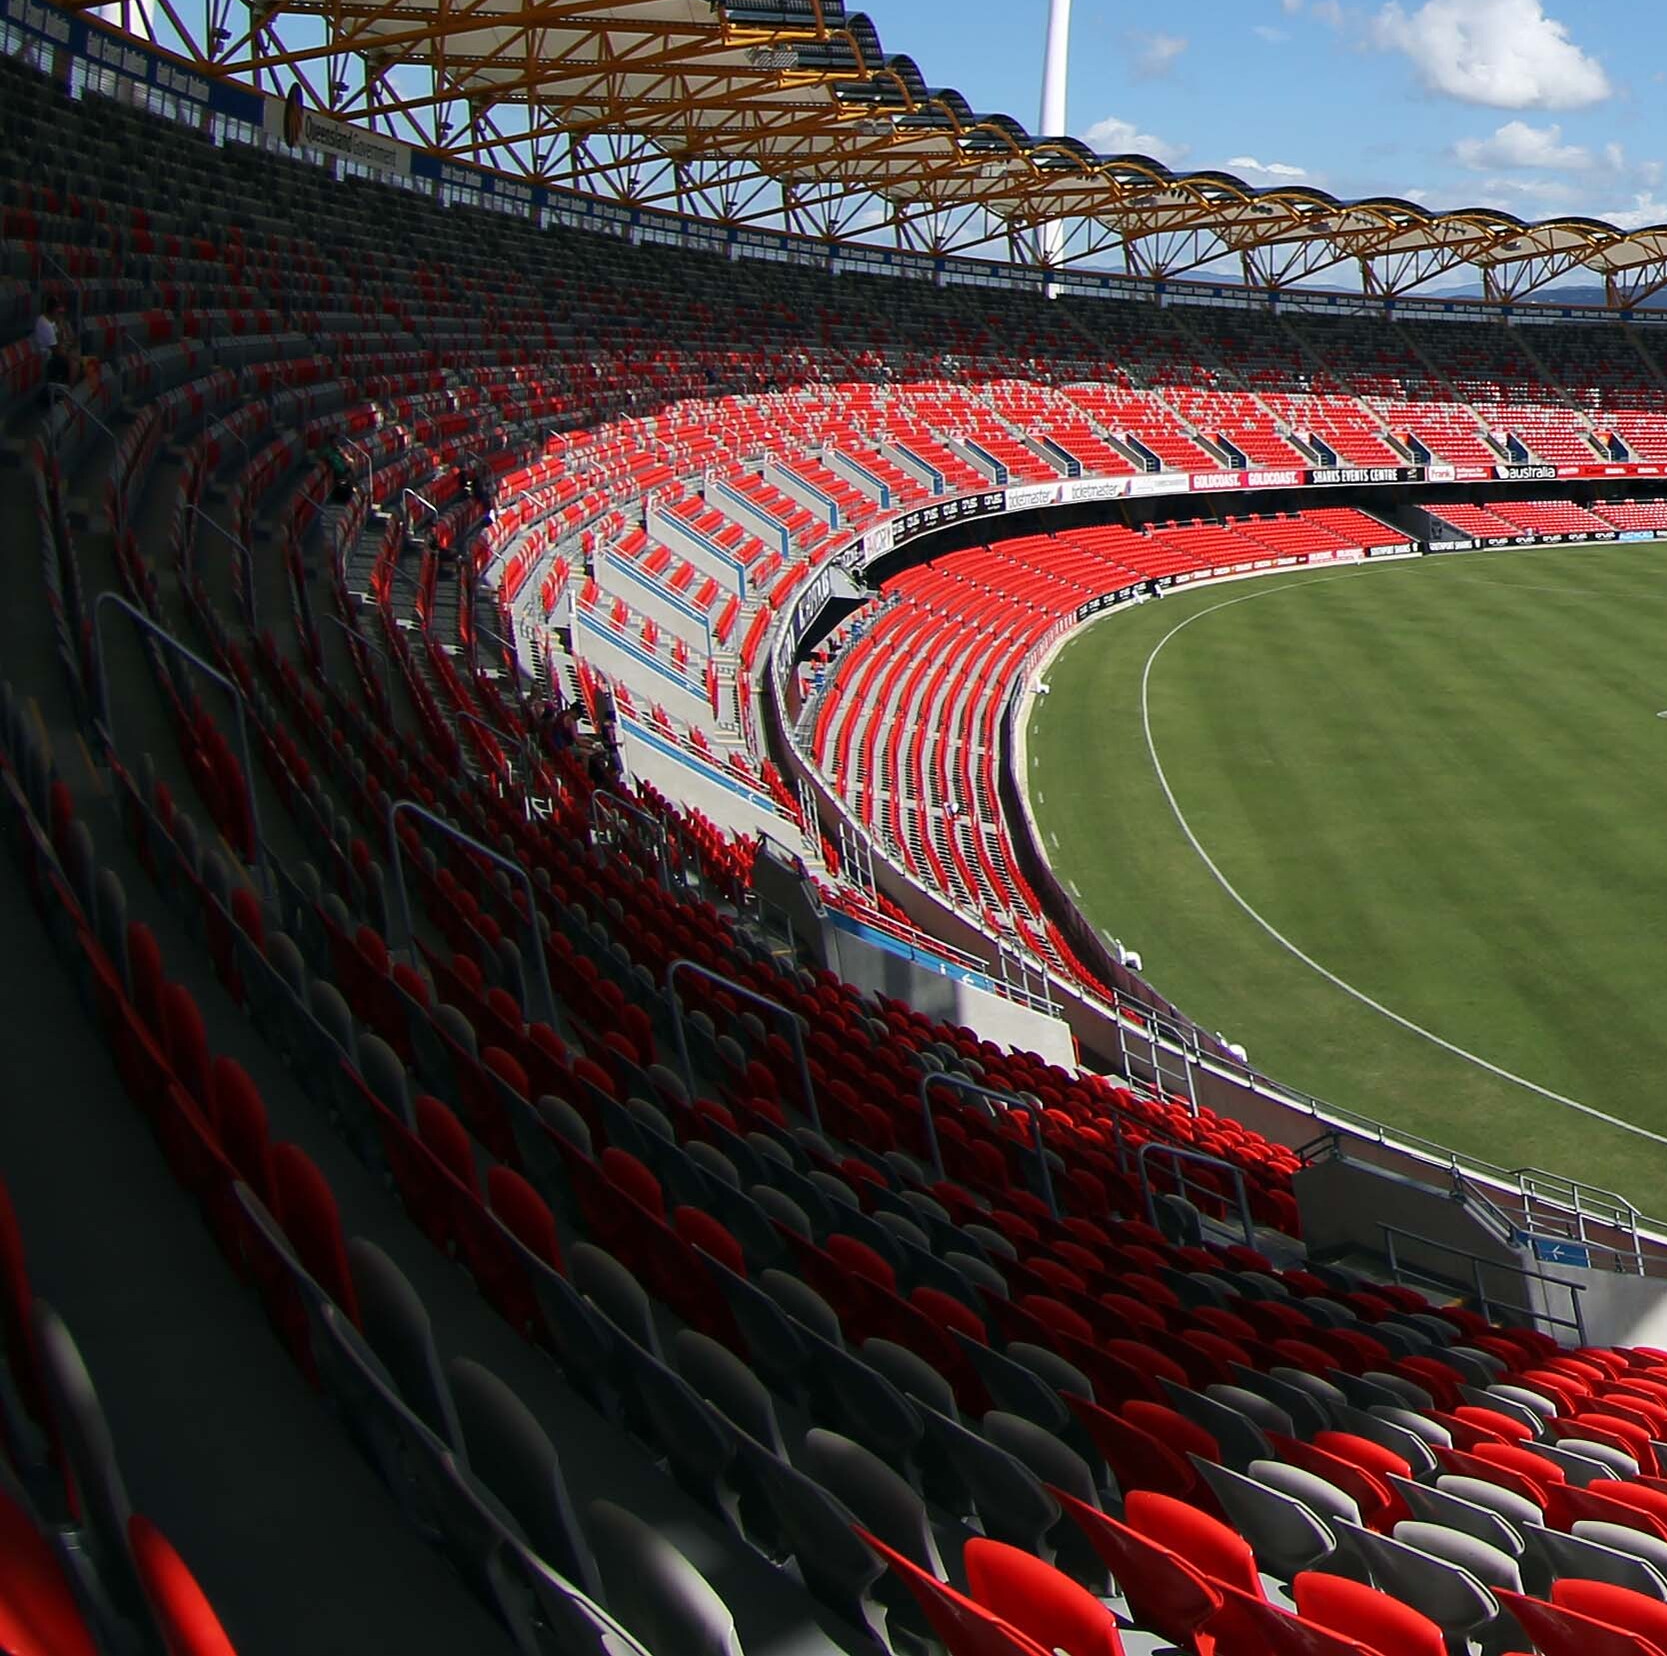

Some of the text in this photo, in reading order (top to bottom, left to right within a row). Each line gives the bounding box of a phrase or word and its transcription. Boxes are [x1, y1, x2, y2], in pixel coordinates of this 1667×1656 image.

[306, 115, 397, 168] Queensland Government
[1248, 471, 1299, 486] GOLDCOAST.
[1313, 469, 1398, 484] SHARKS EVENTS CENTRE
[1508, 465, 1556, 480] australia
[1193, 473, 1241, 489] GOLDCOAST.
[1008, 489, 1052, 509] ticketmaster
[1071, 482, 1119, 501] ticketmaster
